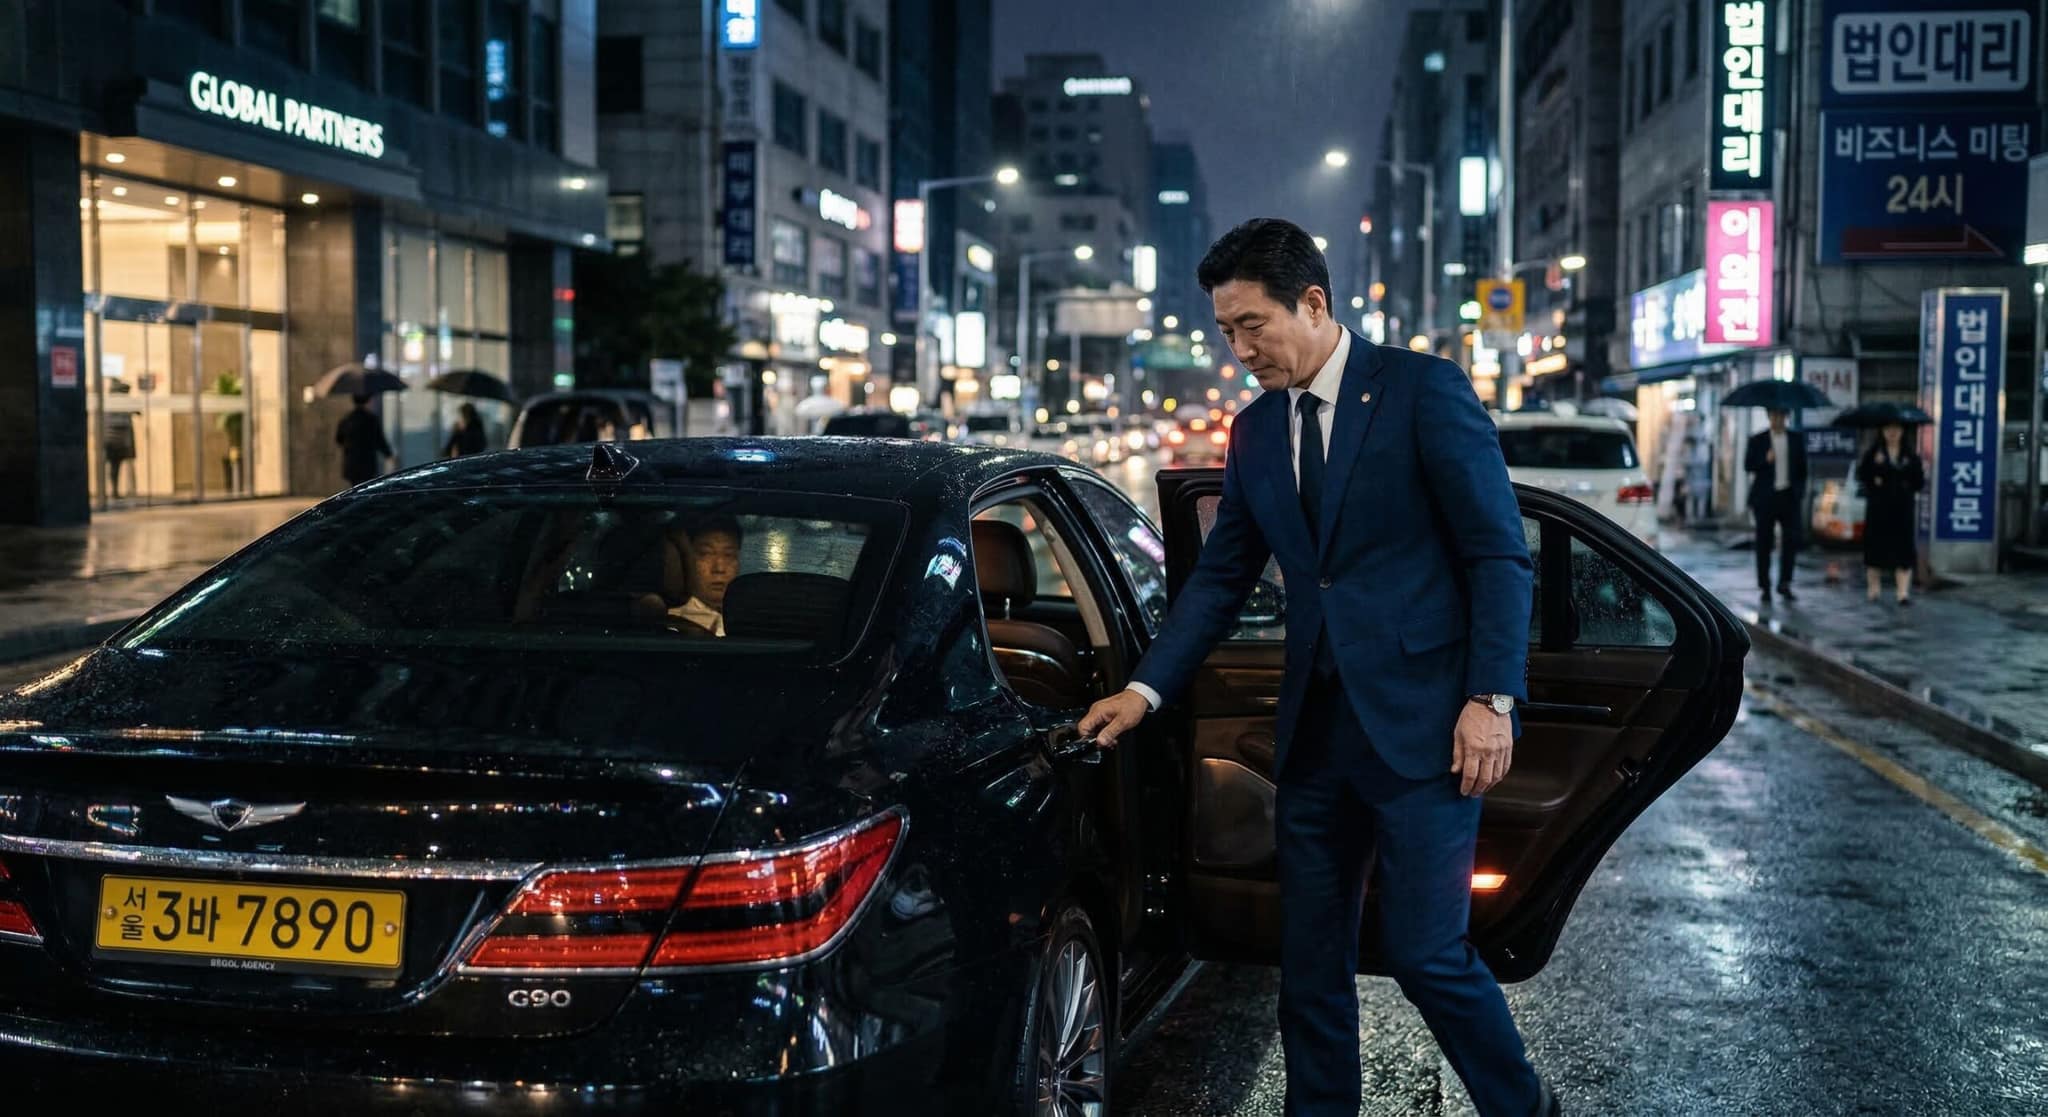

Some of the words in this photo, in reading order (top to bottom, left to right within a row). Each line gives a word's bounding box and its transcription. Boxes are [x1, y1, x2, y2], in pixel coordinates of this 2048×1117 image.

[1843, 19, 2021, 83] 법인대리
[190, 71, 282, 131] GLOBAL
[284, 98, 384, 159] PARTNERS
[1722, 1, 1765, 178] 법인대리
[1835, 123, 1957, 162] 비즈니스
[1969, 123, 2028, 162] 미팅
[1886, 173, 1963, 215] 24시
[1954, 308, 1988, 454] 법인대리
[1950, 460, 1983, 532] 전문
[120, 886, 146, 941] 서울
[153, 891, 220, 942] 3바
[237, 894, 374, 953] 7890
[508, 989, 571, 1007] G90
